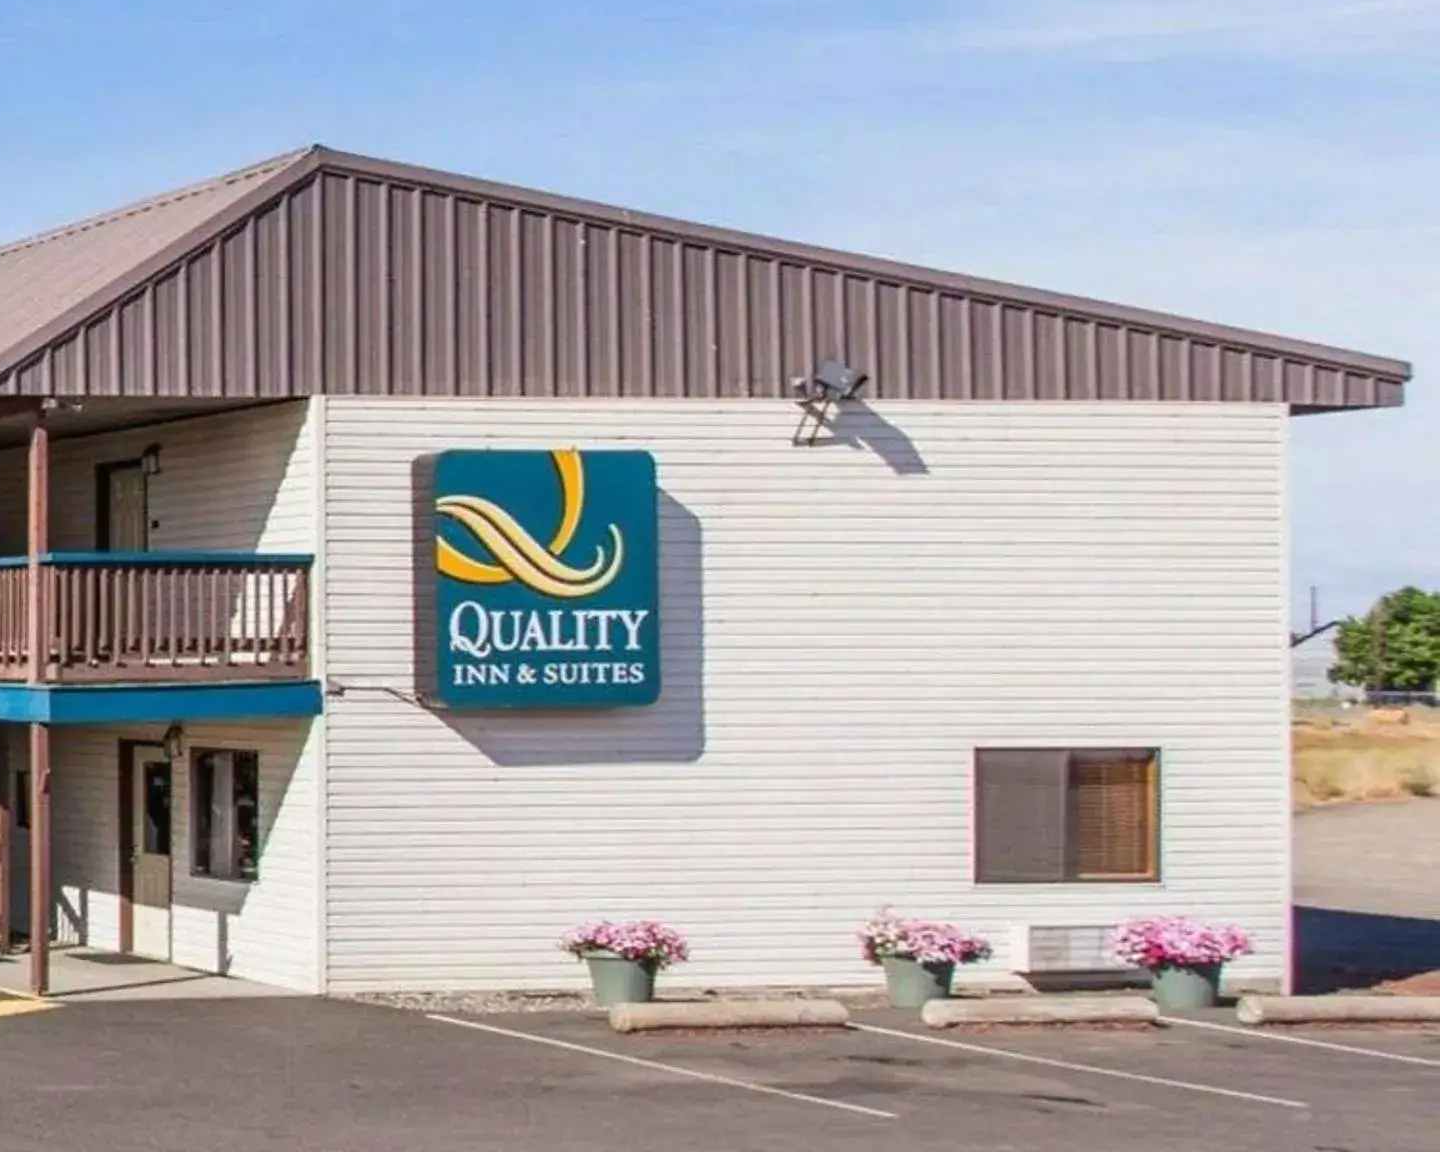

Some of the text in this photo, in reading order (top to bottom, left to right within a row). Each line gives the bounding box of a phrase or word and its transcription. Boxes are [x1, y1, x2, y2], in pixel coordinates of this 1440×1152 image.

[449, 601, 648, 657] QUALITY
[453, 662, 645, 684] INN & SUITES
